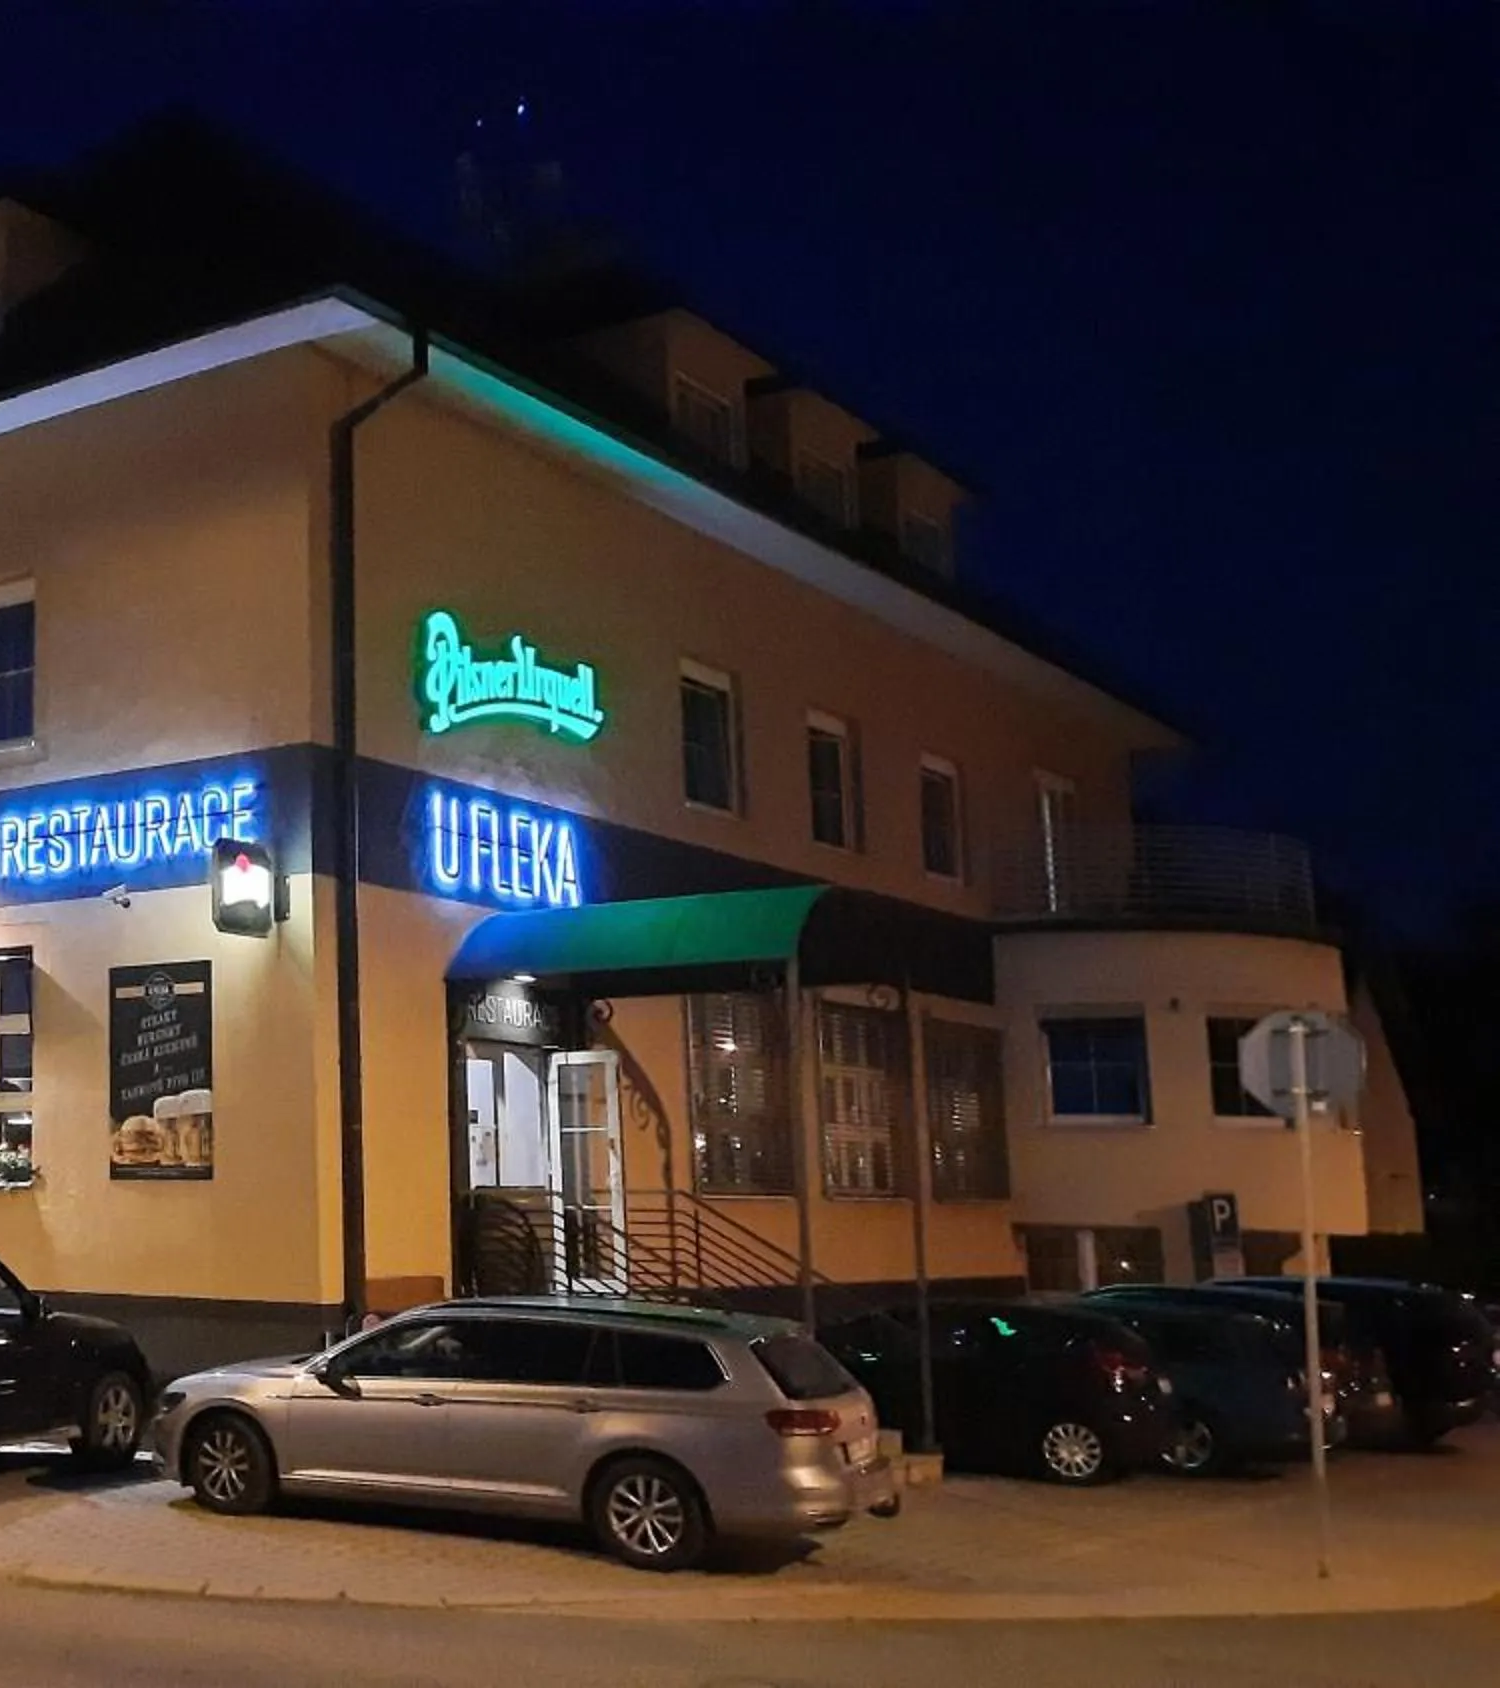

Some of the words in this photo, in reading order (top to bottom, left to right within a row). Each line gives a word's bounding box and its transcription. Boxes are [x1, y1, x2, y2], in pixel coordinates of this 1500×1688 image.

[426, 612, 517, 733] Pilsner
[512, 636, 603, 735] Urquell
[1, 785, 257, 877] RESTAURACE
[433, 792, 461, 884] U
[470, 802, 580, 907] FLEKA
[467, 994, 556, 1034] RESTAURA
[1212, 1198, 1231, 1232] P
